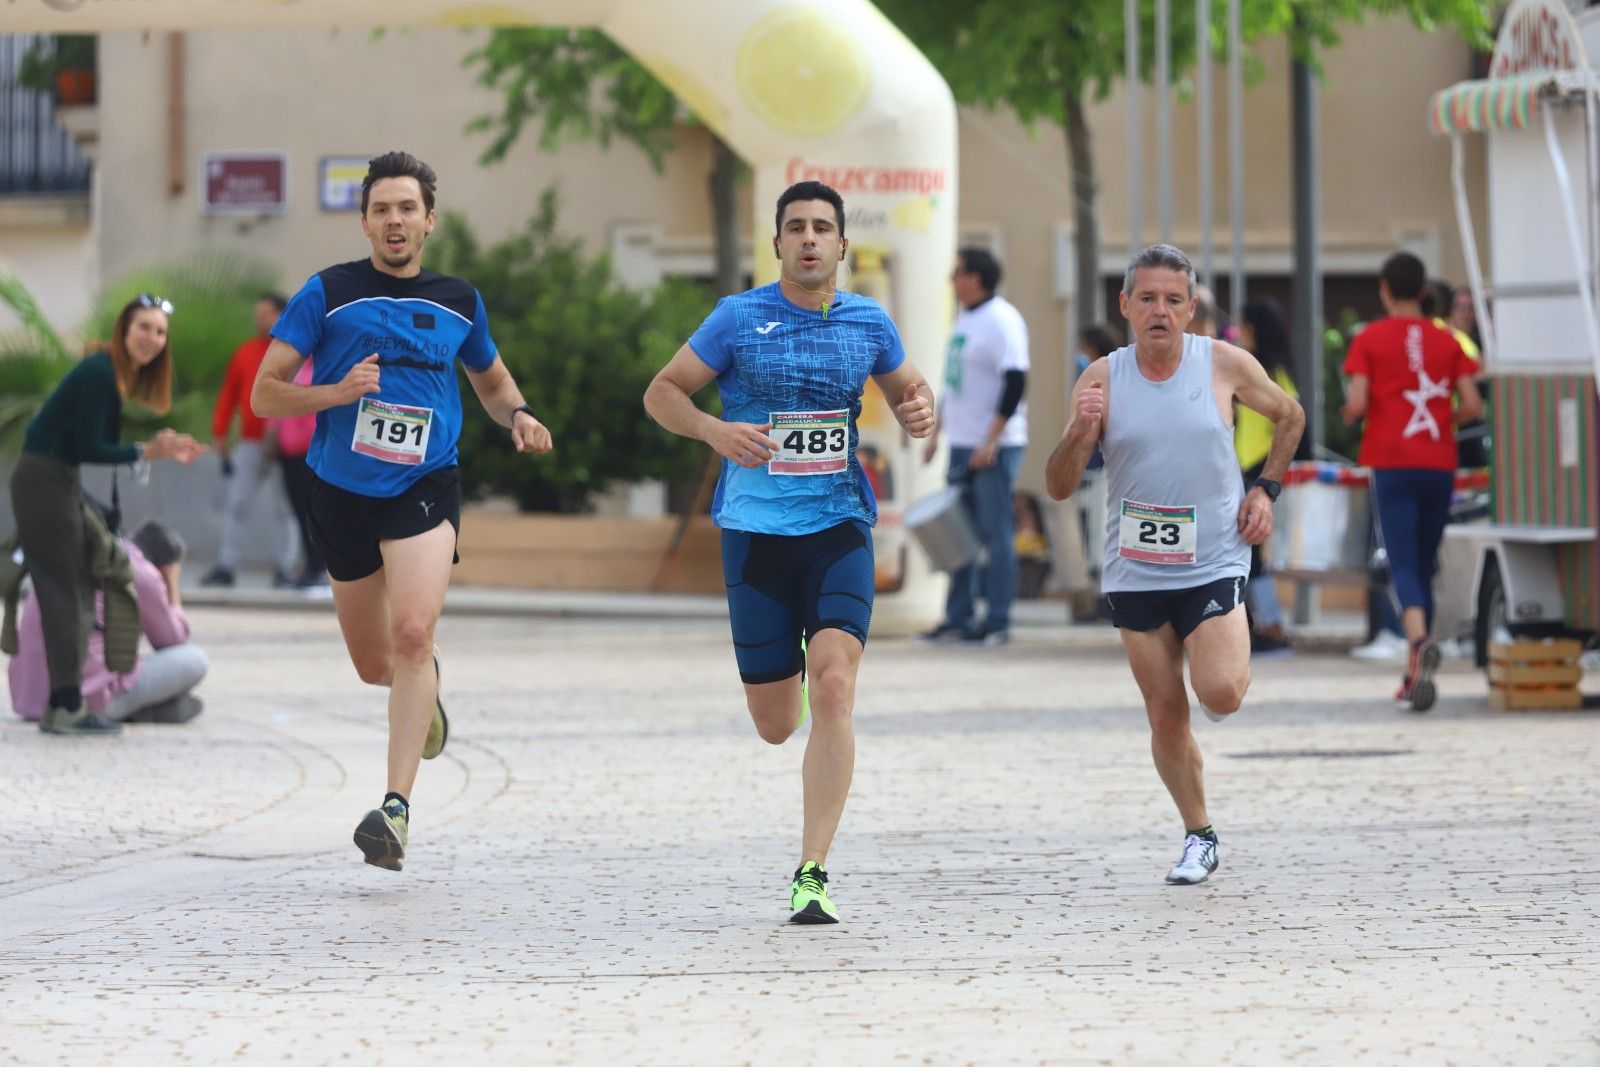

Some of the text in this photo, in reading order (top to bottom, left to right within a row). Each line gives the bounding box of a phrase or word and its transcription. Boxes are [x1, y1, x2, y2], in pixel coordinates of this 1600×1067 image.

[370, 418, 424, 446] 191
[783, 428, 845, 454] 483
[1139, 521, 1180, 546] 23
